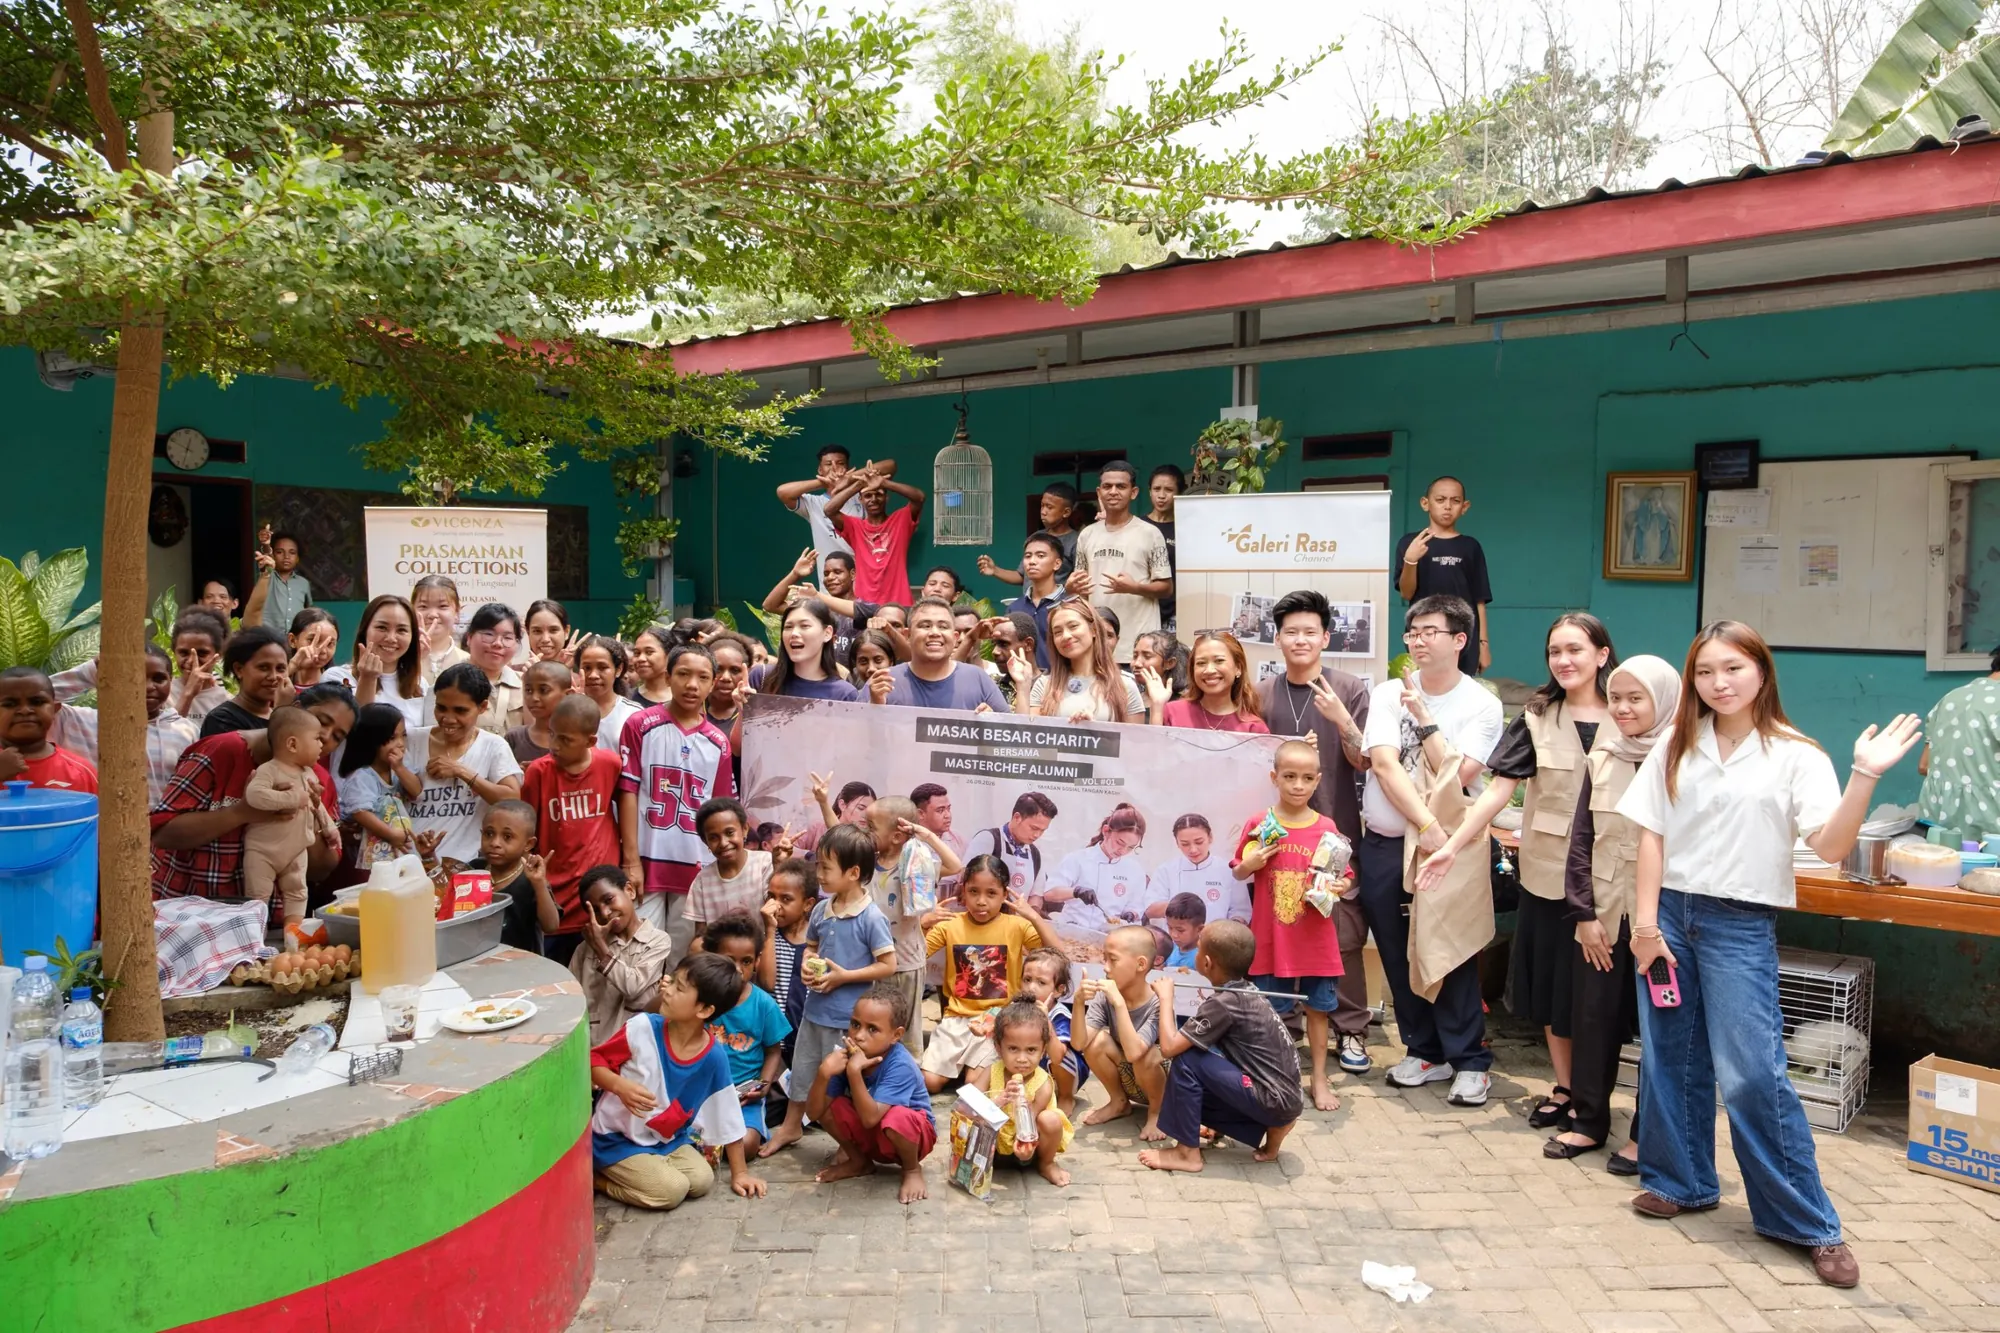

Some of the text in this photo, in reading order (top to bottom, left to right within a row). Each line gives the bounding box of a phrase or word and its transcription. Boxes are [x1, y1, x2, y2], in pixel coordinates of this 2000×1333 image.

[399, 544, 524, 559] PRASMANAN
[1235, 533, 1337, 553] Galeri Rasa
[1293, 553, 1335, 563] Channel
[394, 560, 529, 576] COLLECTIONS
[927, 724, 1101, 749] MASAK BESAR CHARITY
[993, 748, 1040, 757] BERSAMA
[945, 757, 1078, 778] MASTERCHEF ALUMNI
[1081, 778, 1098, 786] VOL
[423, 785, 464, 802] JUST
[646, 764, 707, 835] 55
[408, 801, 476, 818] IMAGINE
[548, 793, 606, 822] CHILL
[1927, 1124, 1969, 1154] 15
